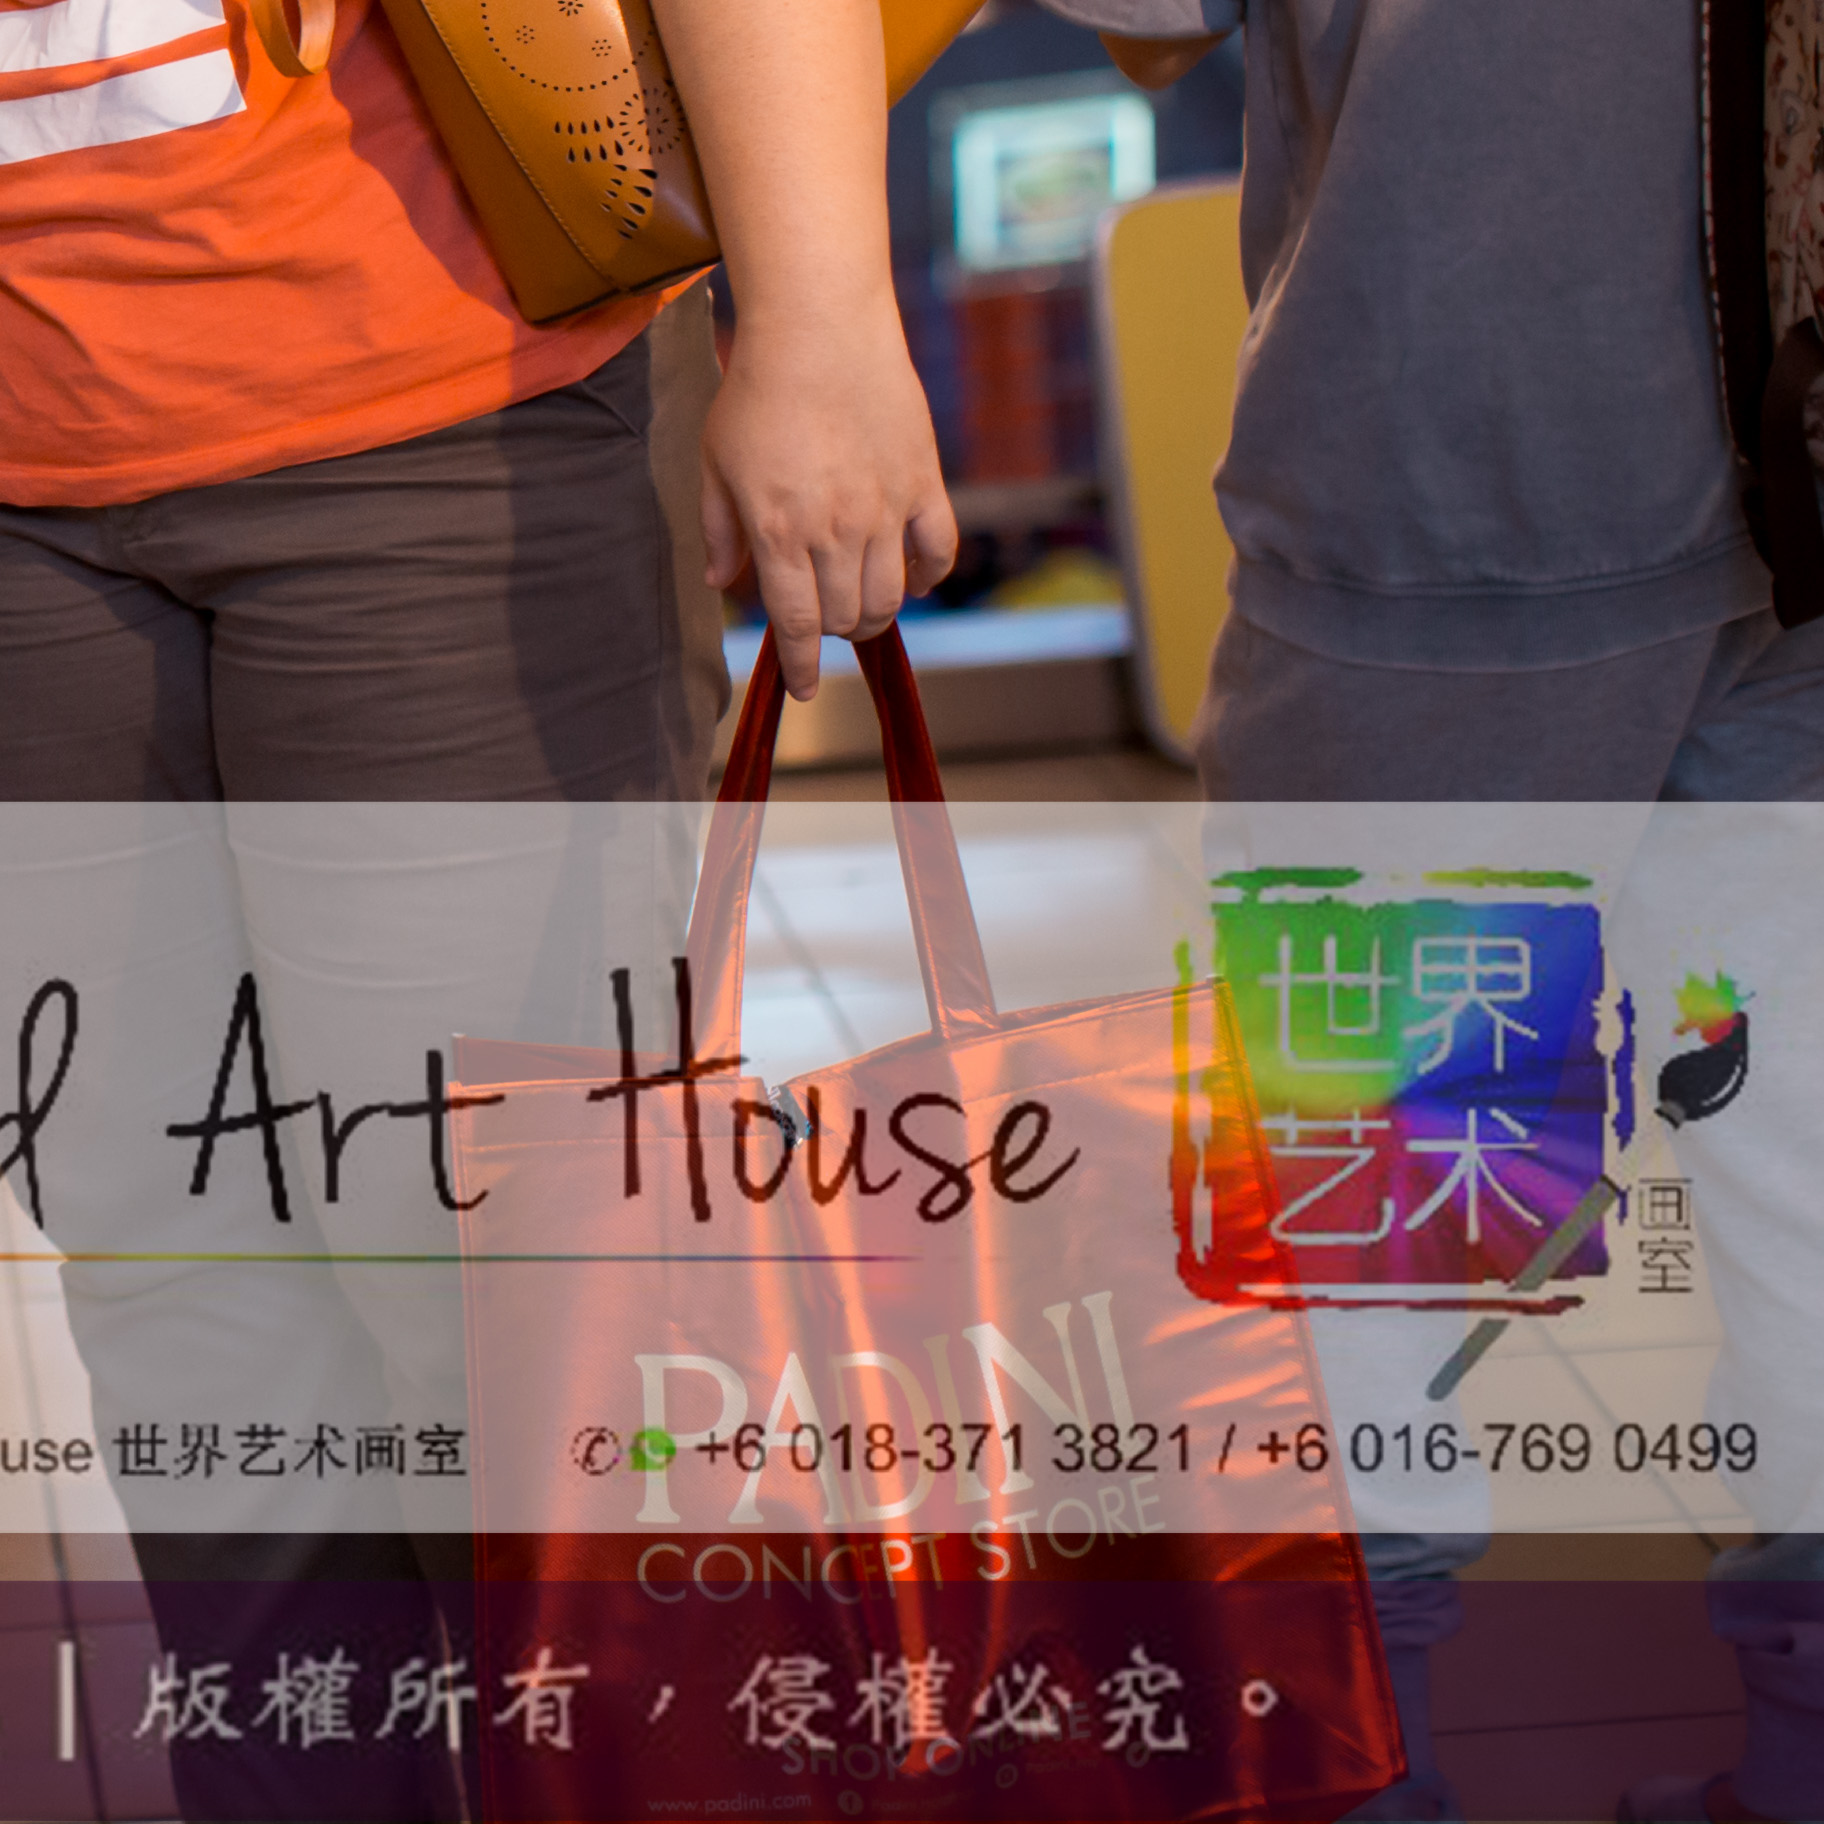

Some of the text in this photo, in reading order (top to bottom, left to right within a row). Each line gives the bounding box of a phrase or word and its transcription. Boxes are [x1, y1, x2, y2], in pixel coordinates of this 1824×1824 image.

[633, 1289, 1142, 1526] PADINI
[636, 1473, 1168, 1606] CONCEPT STORE
[646, 1791, 813, 1816] www.padini.com
